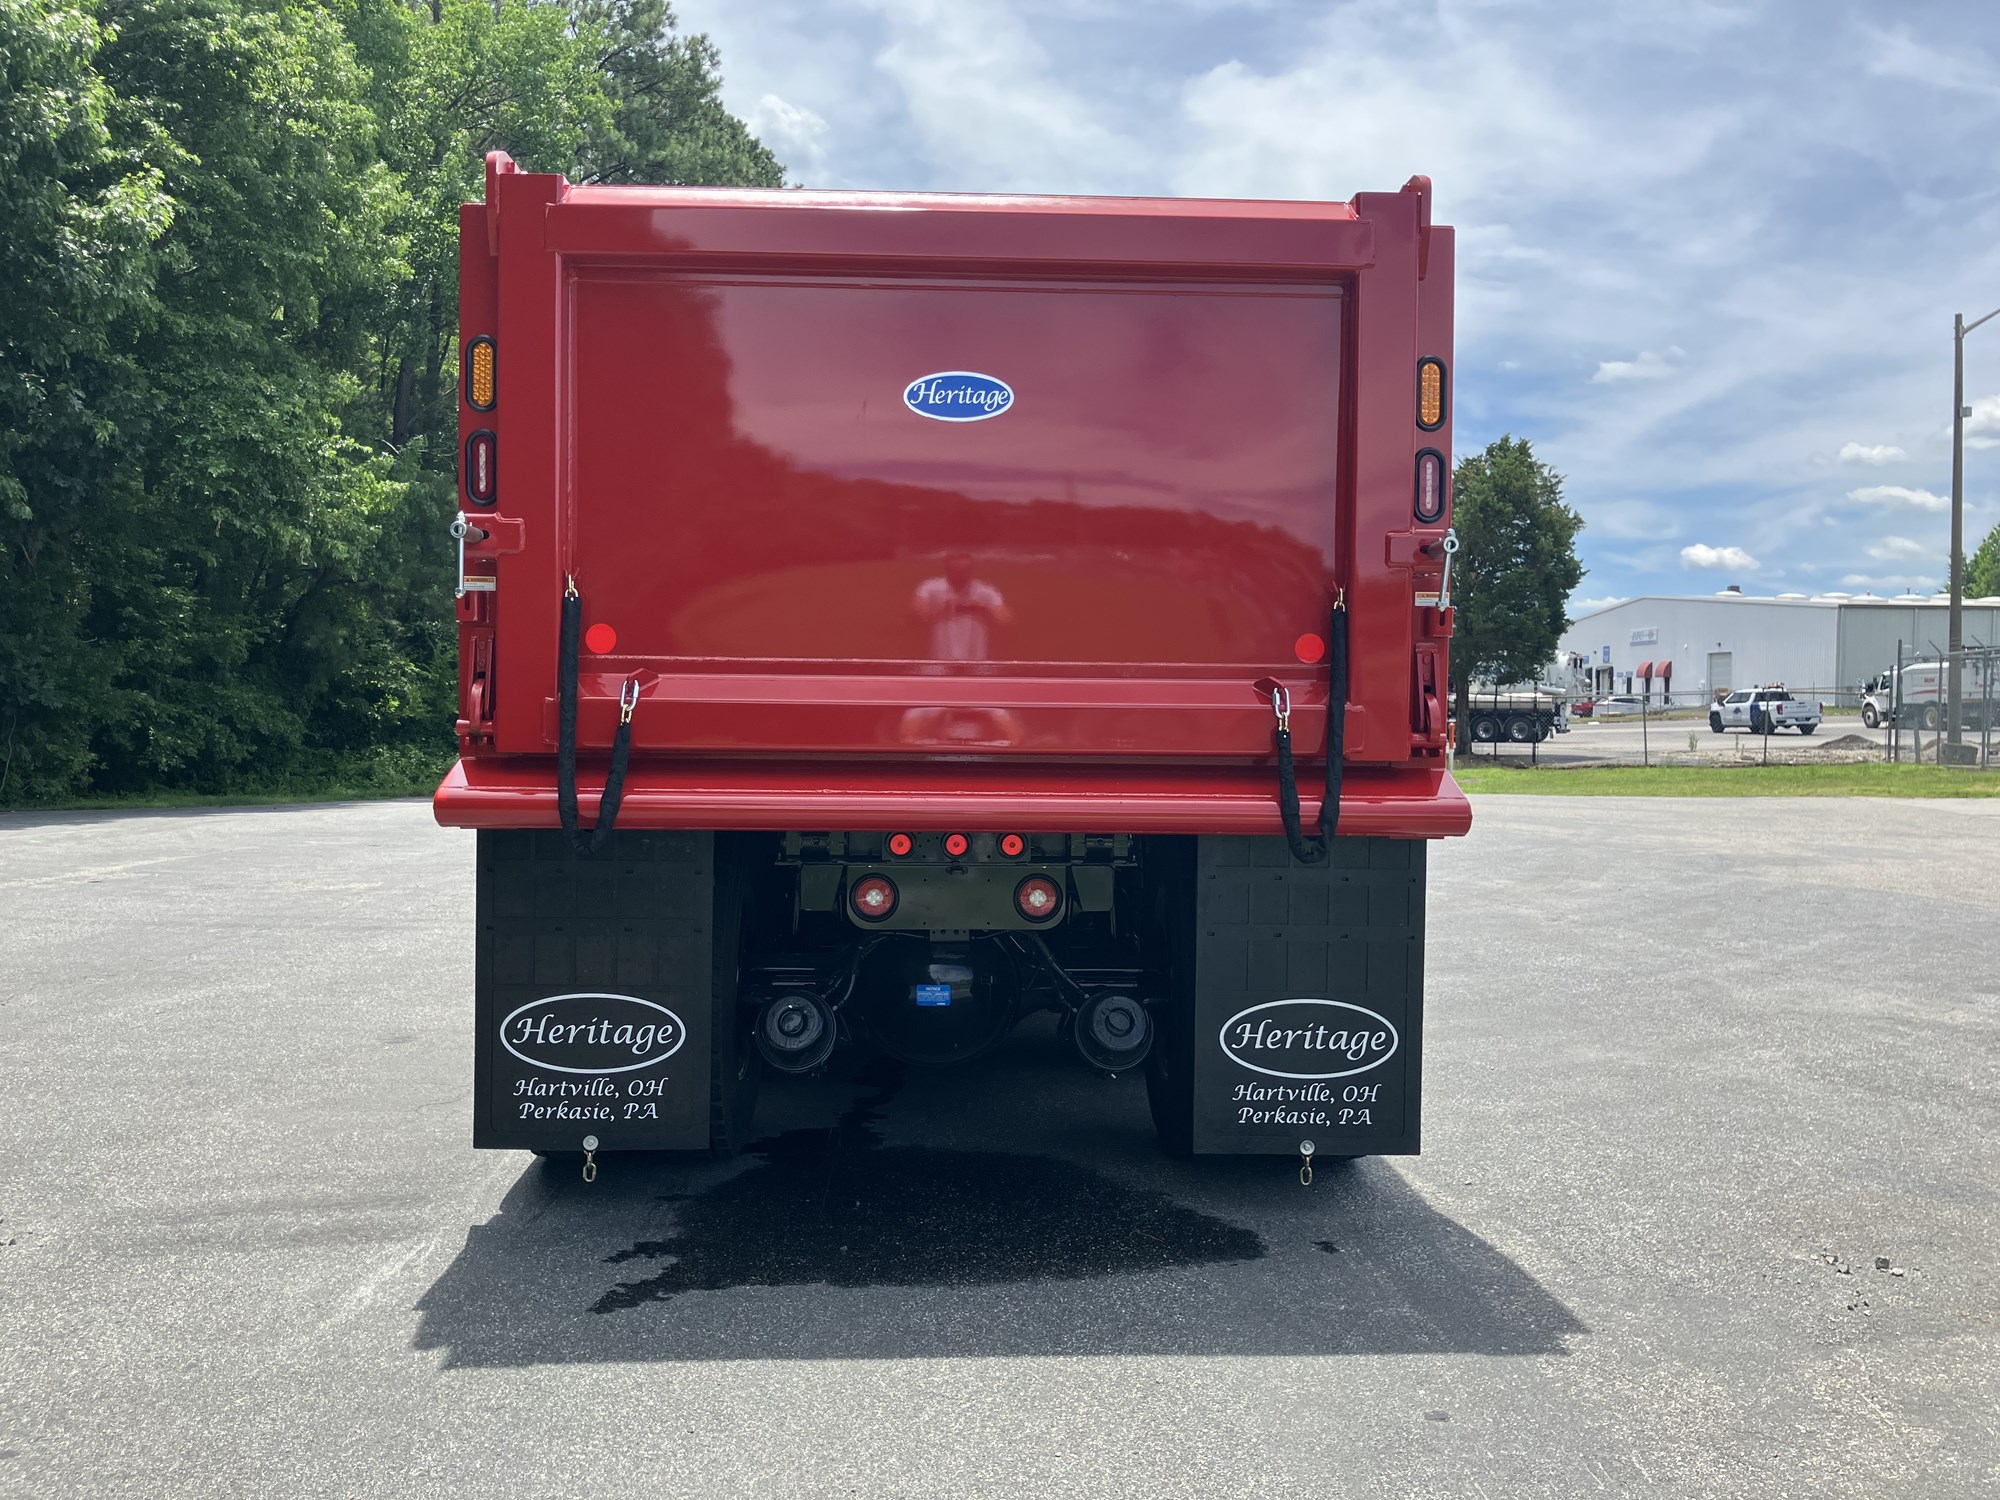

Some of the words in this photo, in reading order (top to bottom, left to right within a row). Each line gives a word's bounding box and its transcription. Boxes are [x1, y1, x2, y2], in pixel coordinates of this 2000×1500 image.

[909, 379, 1009, 411] Heritage
[512, 1013, 673, 1055] Heritage
[1231, 1018, 1386, 1061] Heritage
[513, 1078, 619, 1098] Hartville,
[628, 1078, 668, 1096] OH
[1232, 1082, 1334, 1104] Hartville,
[1343, 1084, 1381, 1102] OH
[519, 1101, 615, 1121] Perkasie,
[624, 1103, 658, 1119] PA
[1238, 1106, 1331, 1126] Perkasie,
[1339, 1108, 1372, 1124] PA
